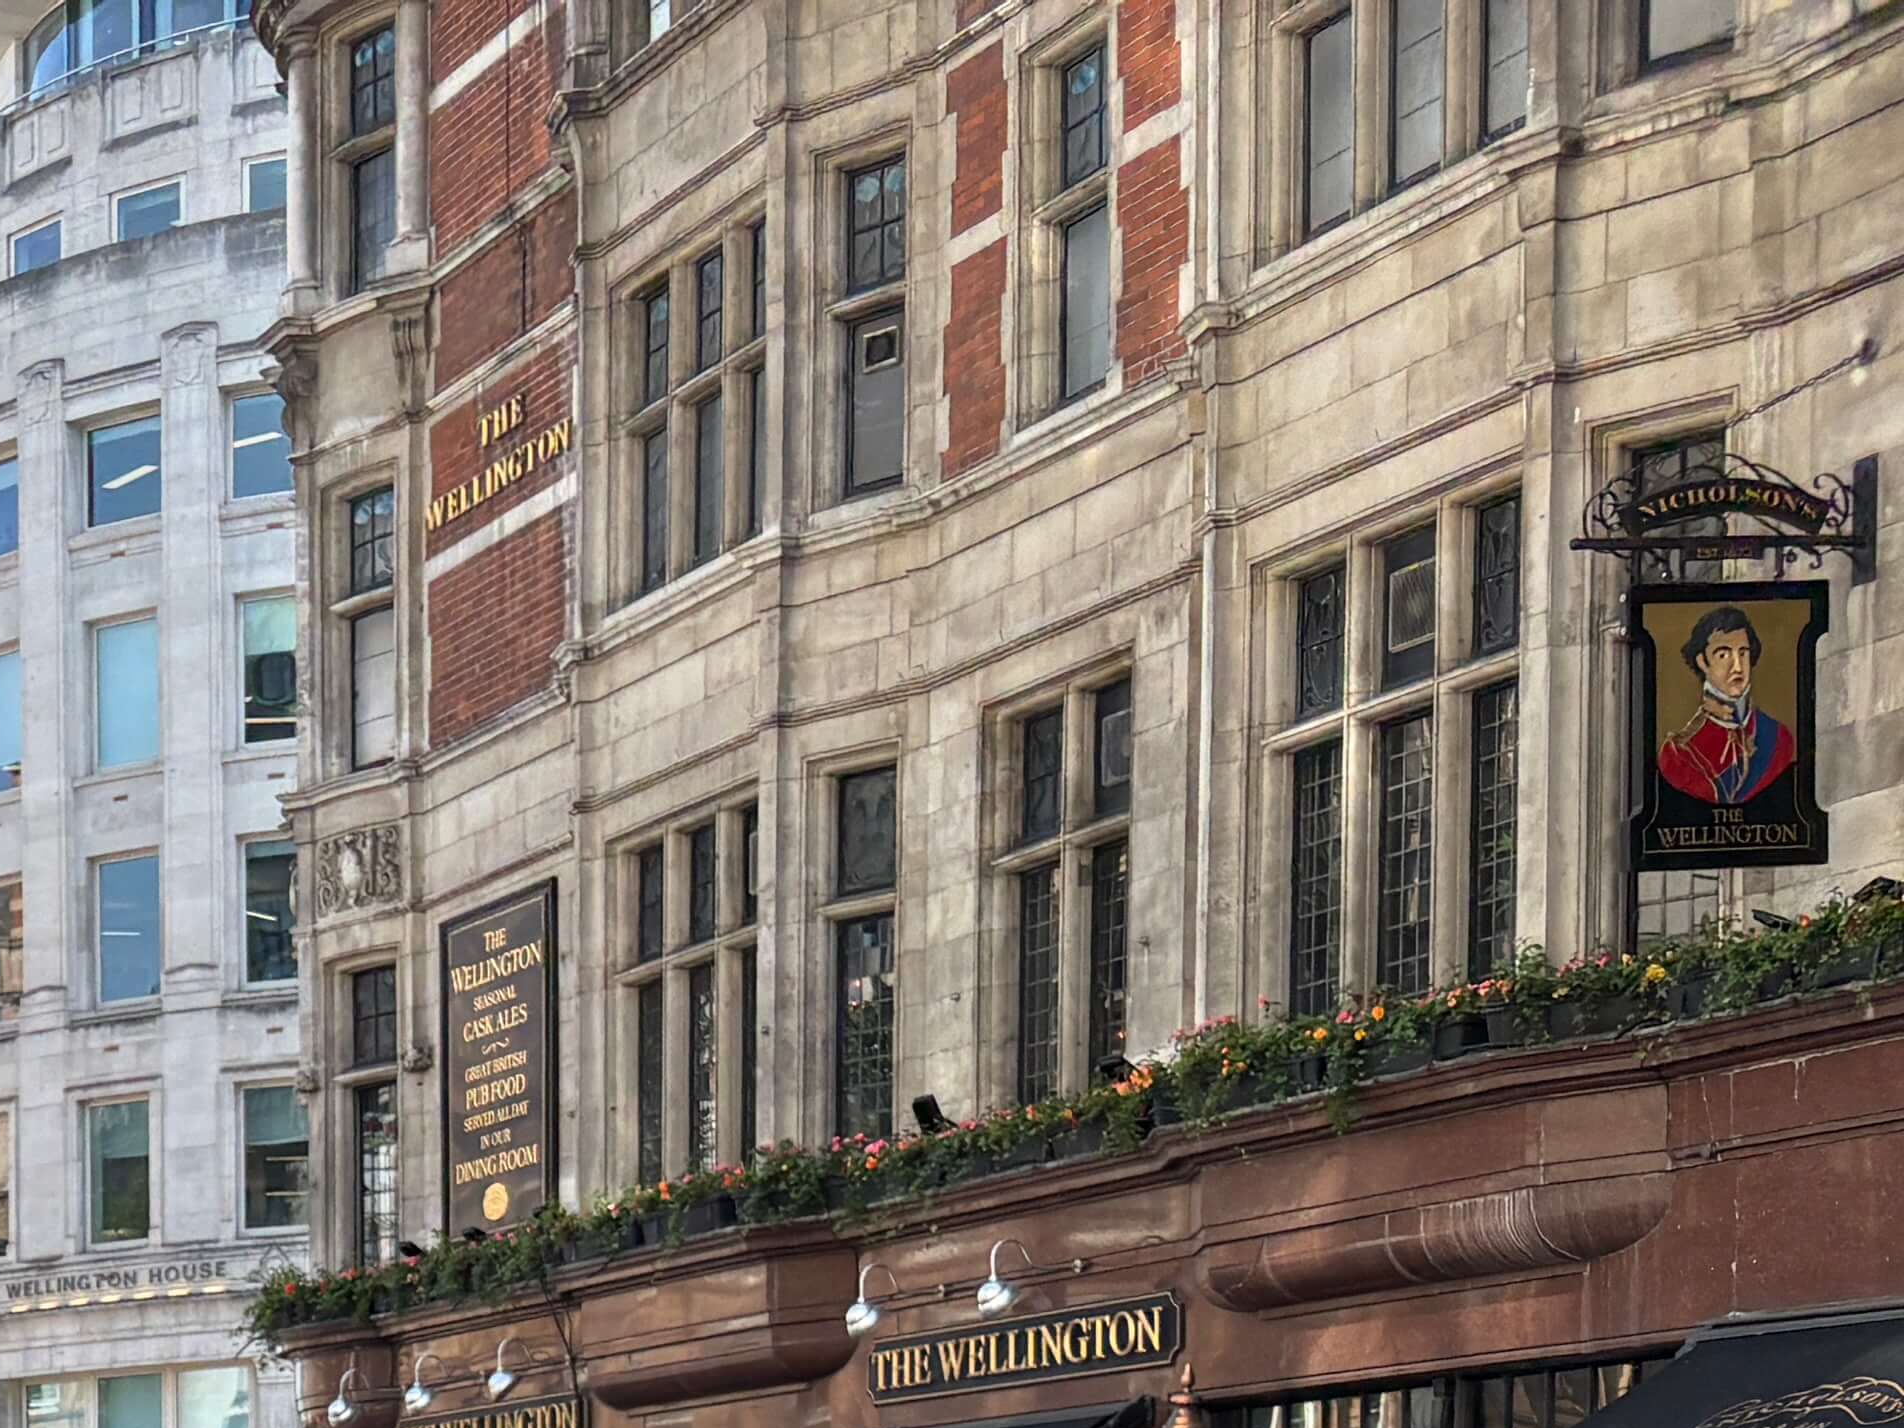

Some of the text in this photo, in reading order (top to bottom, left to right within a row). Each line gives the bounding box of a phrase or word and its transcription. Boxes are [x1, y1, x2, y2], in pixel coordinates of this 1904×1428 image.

[477, 394, 526, 447] THE
[425, 417, 571, 532] WELLINGTON
[1638, 486, 1818, 521] NICHOLSON'S
[1712, 808, 1745, 823] THE
[1657, 823, 1798, 849] WELLINGTON
[483, 927, 507, 952] THE
[450, 939, 544, 995] WELLINGTON
[472, 984, 518, 1012] SEASONAL
[463, 1003, 528, 1042] CASK ALES
[464, 1050, 527, 1083] GREAT BRITISH
[465, 1073, 527, 1110] PUB FOOD
[463, 1100, 530, 1133] SERVED ALL DAY
[480, 1128, 512, 1150] IN OUR
[455, 1143, 539, 1184] DINING ROOM
[6, 1261, 227, 1299] WELLINGTON HOUSE
[872, 1306, 1163, 1391] THE WELLINGTON
